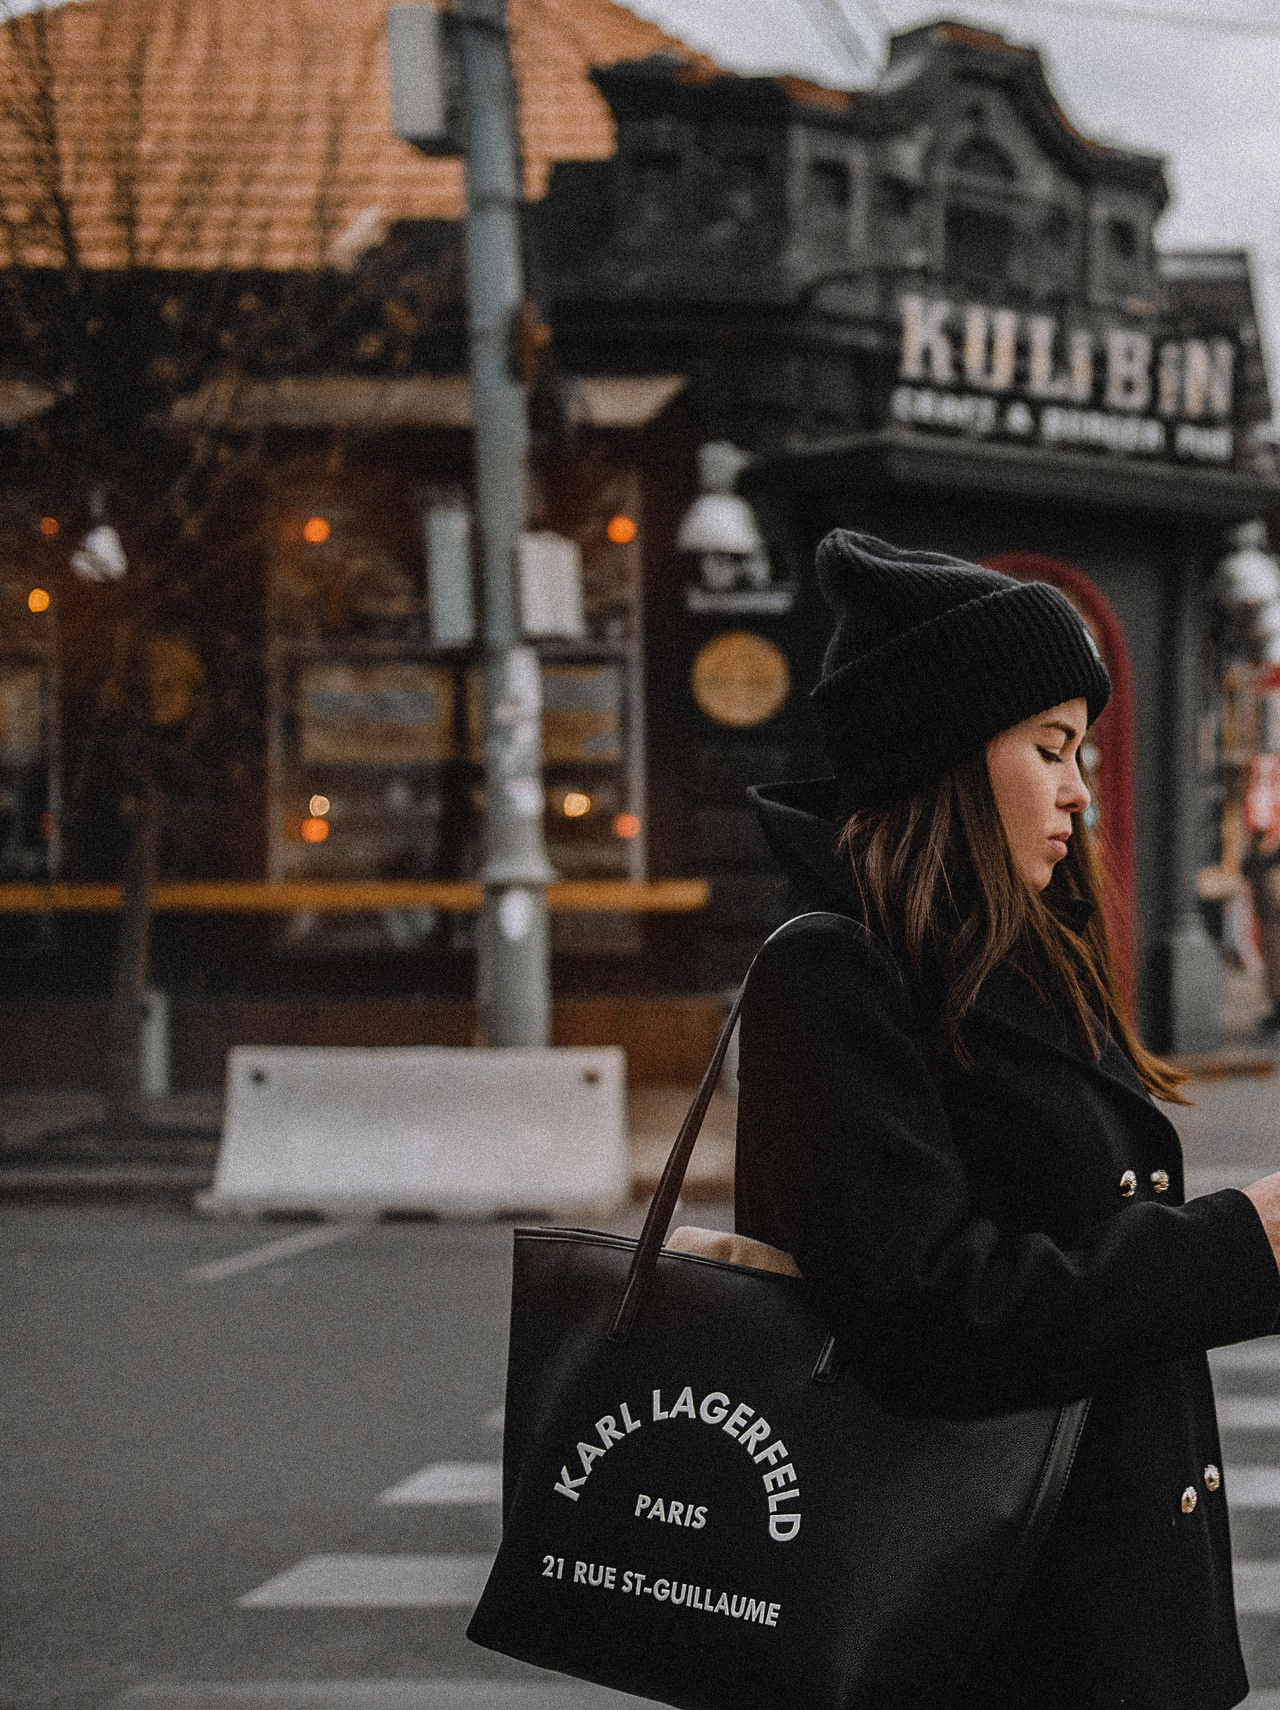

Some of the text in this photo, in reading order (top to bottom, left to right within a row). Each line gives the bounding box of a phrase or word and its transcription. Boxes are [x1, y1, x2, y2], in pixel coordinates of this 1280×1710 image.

[553, 1386, 802, 1542] KARL LAGERFELD
[634, 1493, 709, 1530] PARIS
[541, 1554, 782, 1627] 21 RUE ST-GUILLAUME
